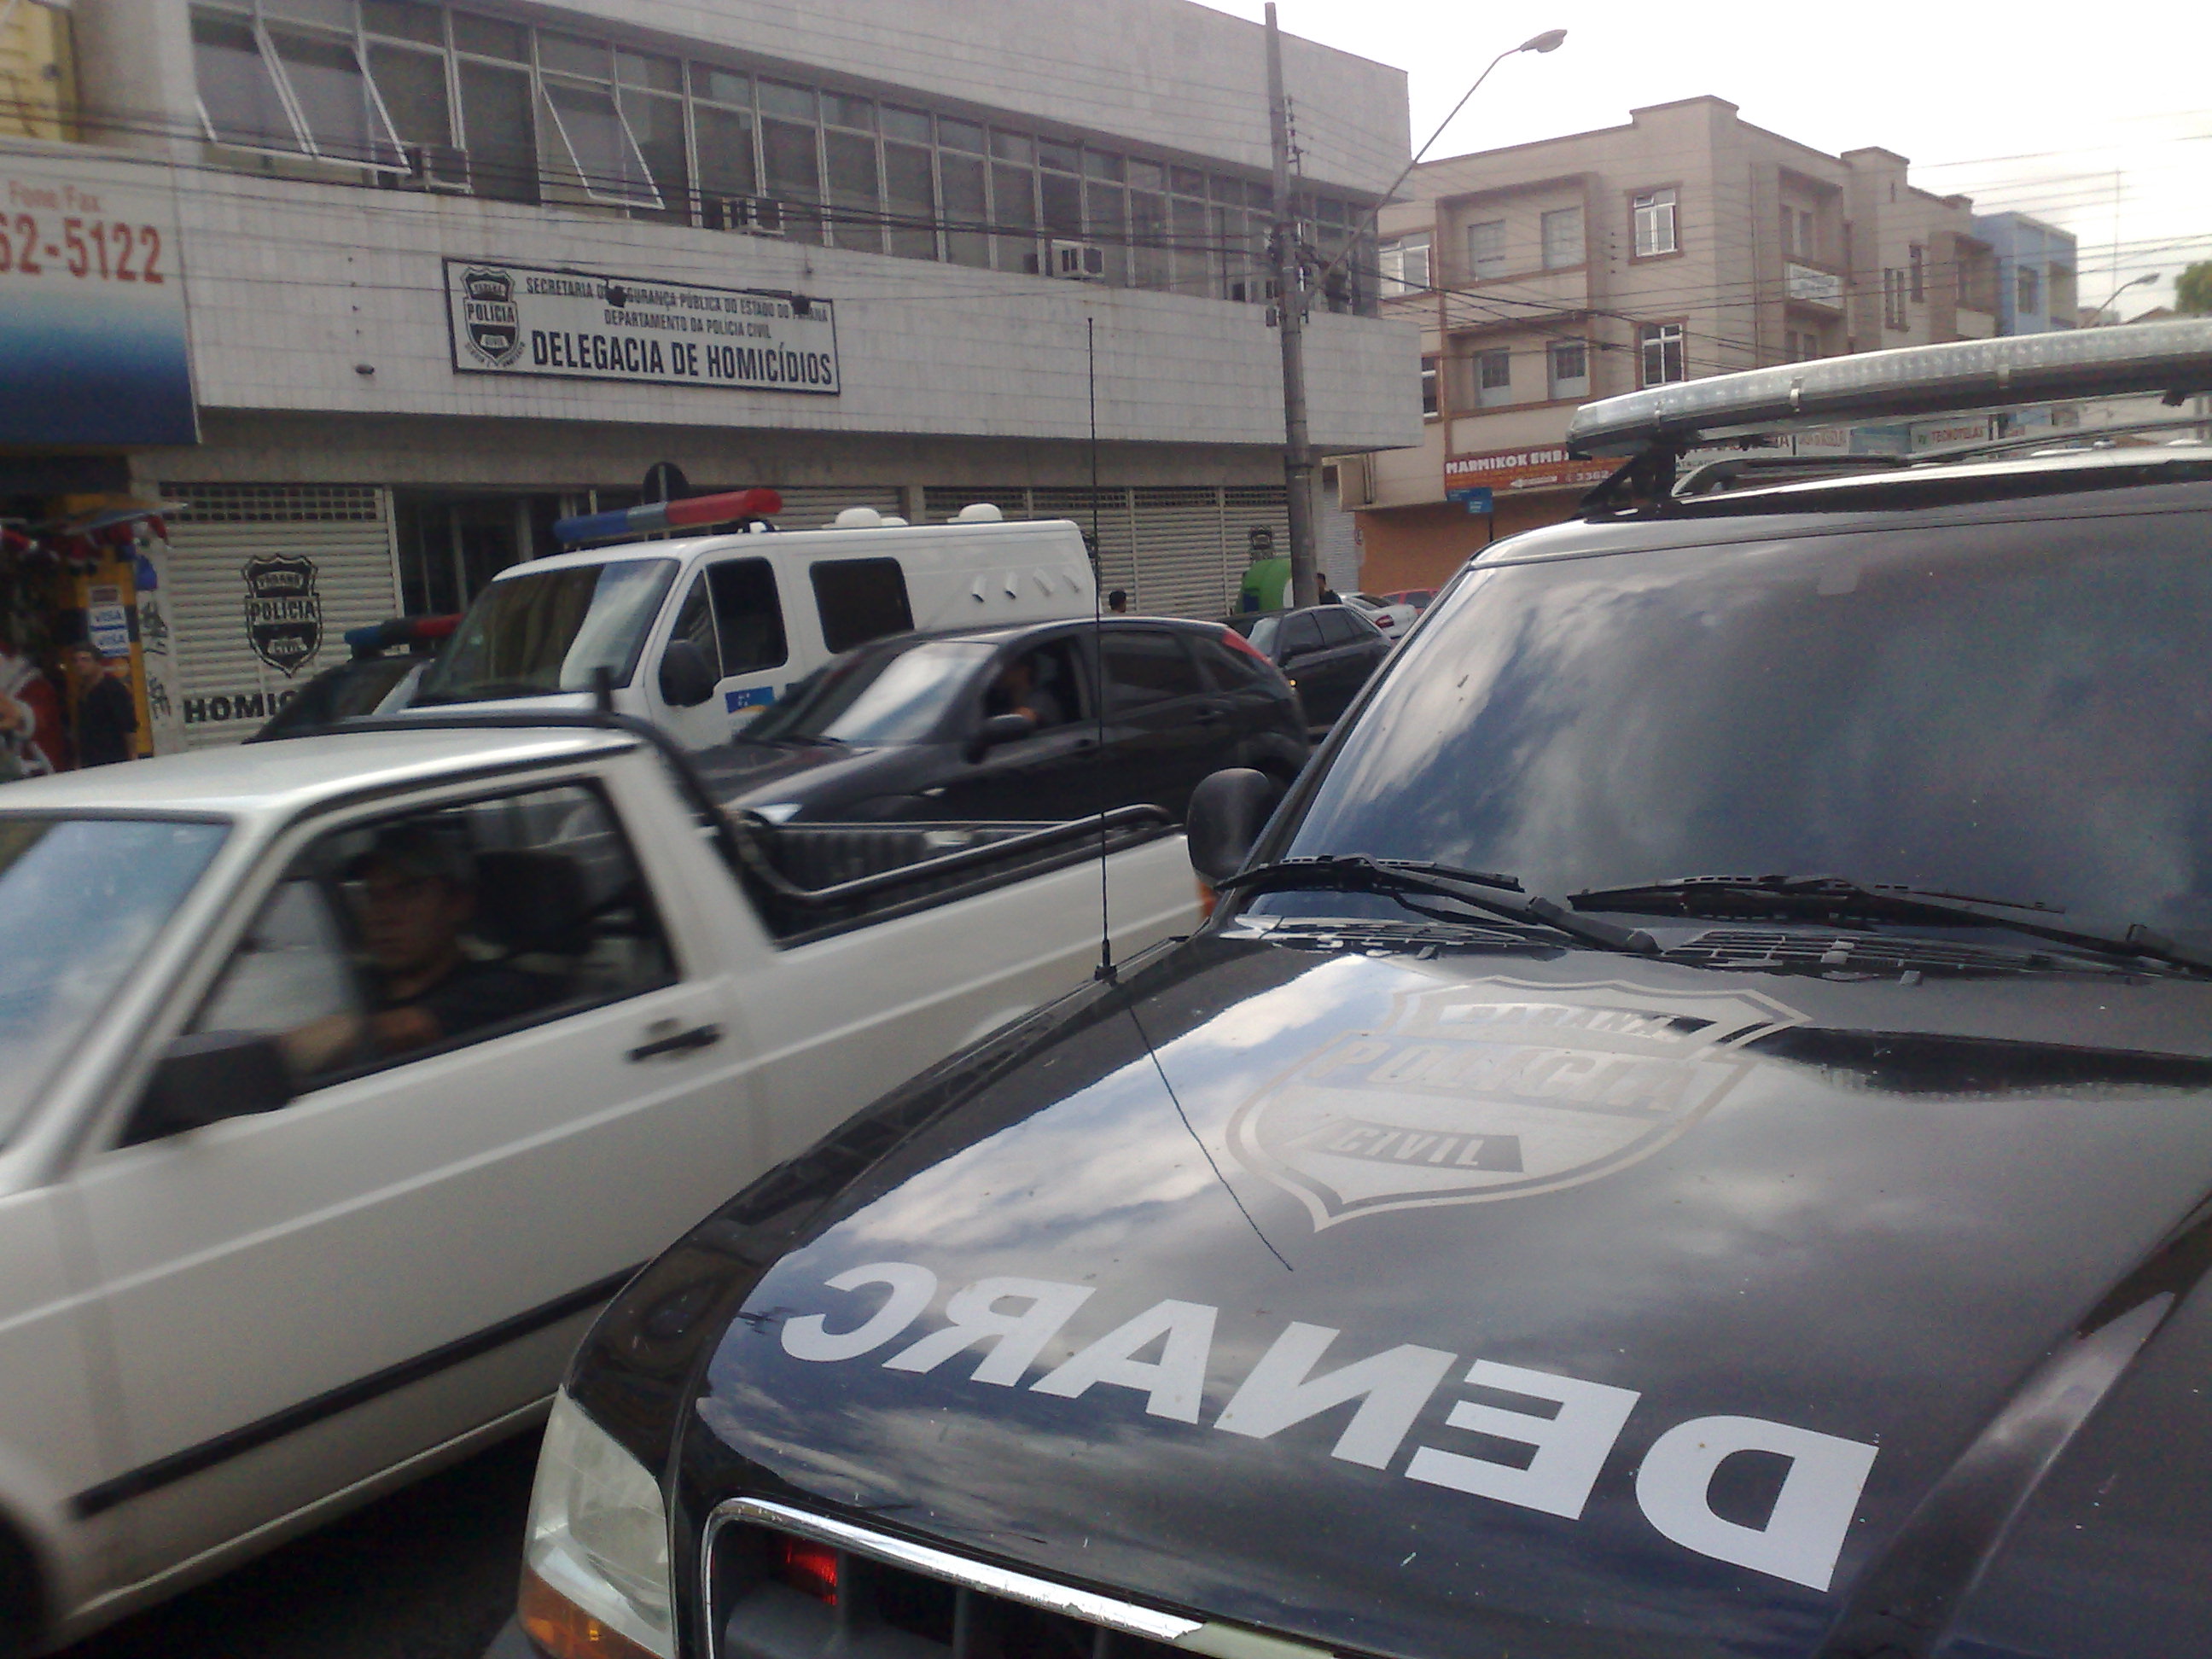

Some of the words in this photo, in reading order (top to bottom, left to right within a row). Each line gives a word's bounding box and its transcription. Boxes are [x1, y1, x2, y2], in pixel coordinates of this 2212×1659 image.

[526, 276, 594, 299] SECRETARIA
[680, 293, 722, 312] PÚBLICA
[740, 299, 774, 317] ESTADO
[603, 308, 687, 333] DEPARTAMENTO
[690, 317, 703, 332] DA
[747, 322, 771, 339] CIVIL
[532, 329, 664, 374] DELEGACIA
[672, 341, 698, 376] DE
[707, 341, 832, 385] HOMICÍDIOS
[1325, 1127, 1485, 1167] CIVIL
